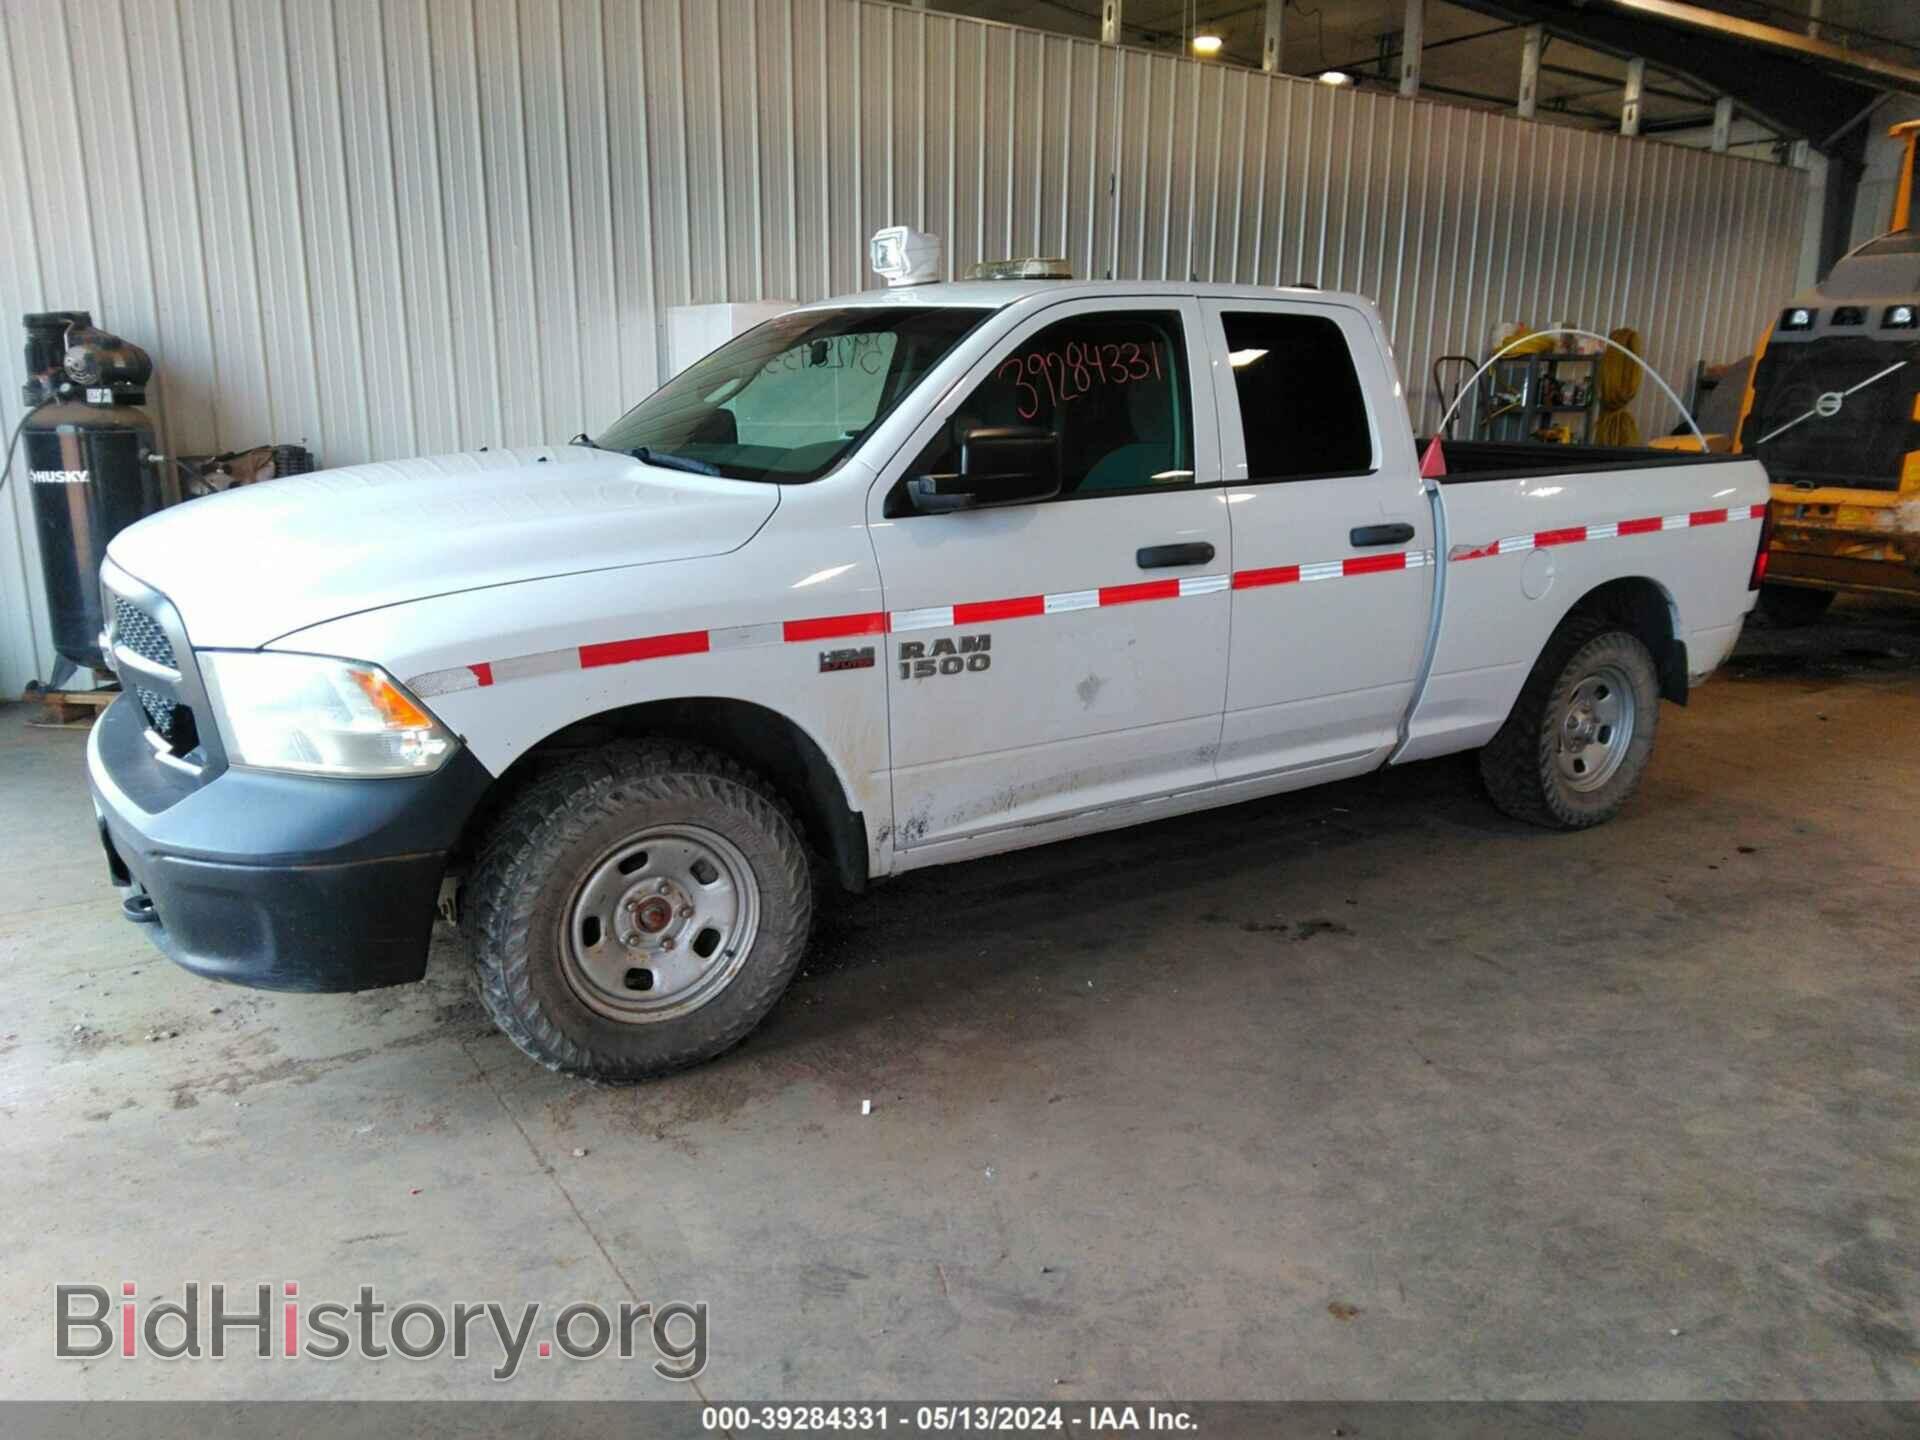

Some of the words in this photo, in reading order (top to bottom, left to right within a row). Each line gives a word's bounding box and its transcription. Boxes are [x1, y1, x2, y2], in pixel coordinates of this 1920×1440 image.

[997, 340, 1161, 419] 39284331
[36, 470, 89, 483] HUSKY
[898, 634, 991, 660] RAM
[900, 653, 991, 680] 1500
